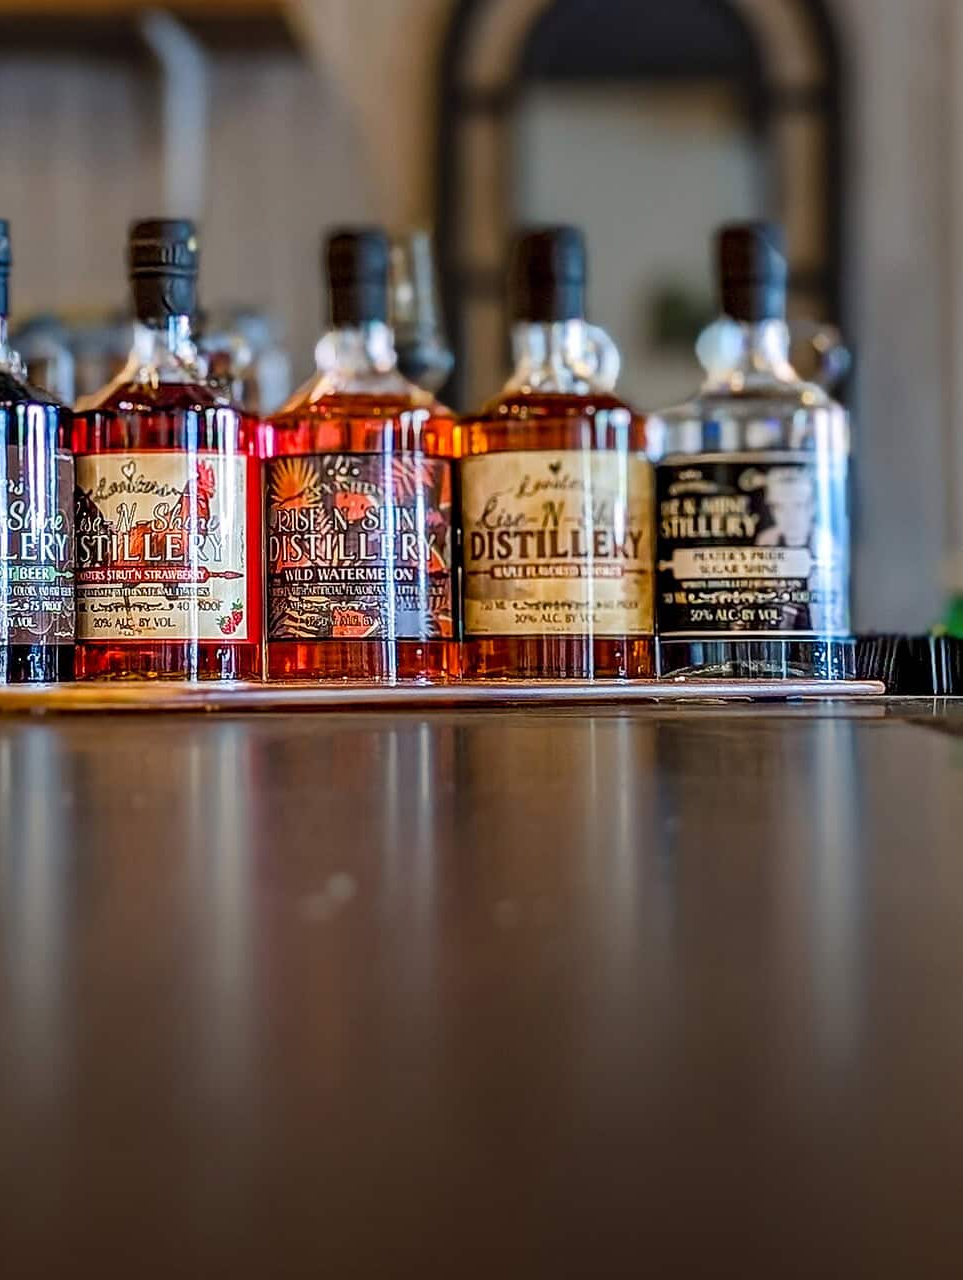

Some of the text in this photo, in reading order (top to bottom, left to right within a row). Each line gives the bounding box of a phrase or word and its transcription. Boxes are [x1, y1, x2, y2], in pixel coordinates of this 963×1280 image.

[269, 533, 436, 563] DISTILLERY
[470, 529, 644, 561] DISTILLERY
[19, 567, 51, 581] BEER
[145, 568, 206, 581] STRAWBERRY
[284, 567, 414, 582] WILD WATERMEON
[177, 601, 190, 613] 40
[93, 617, 113, 629] 20%
[138, 617, 151, 629] BY
[153, 617, 177, 629] VOL.
